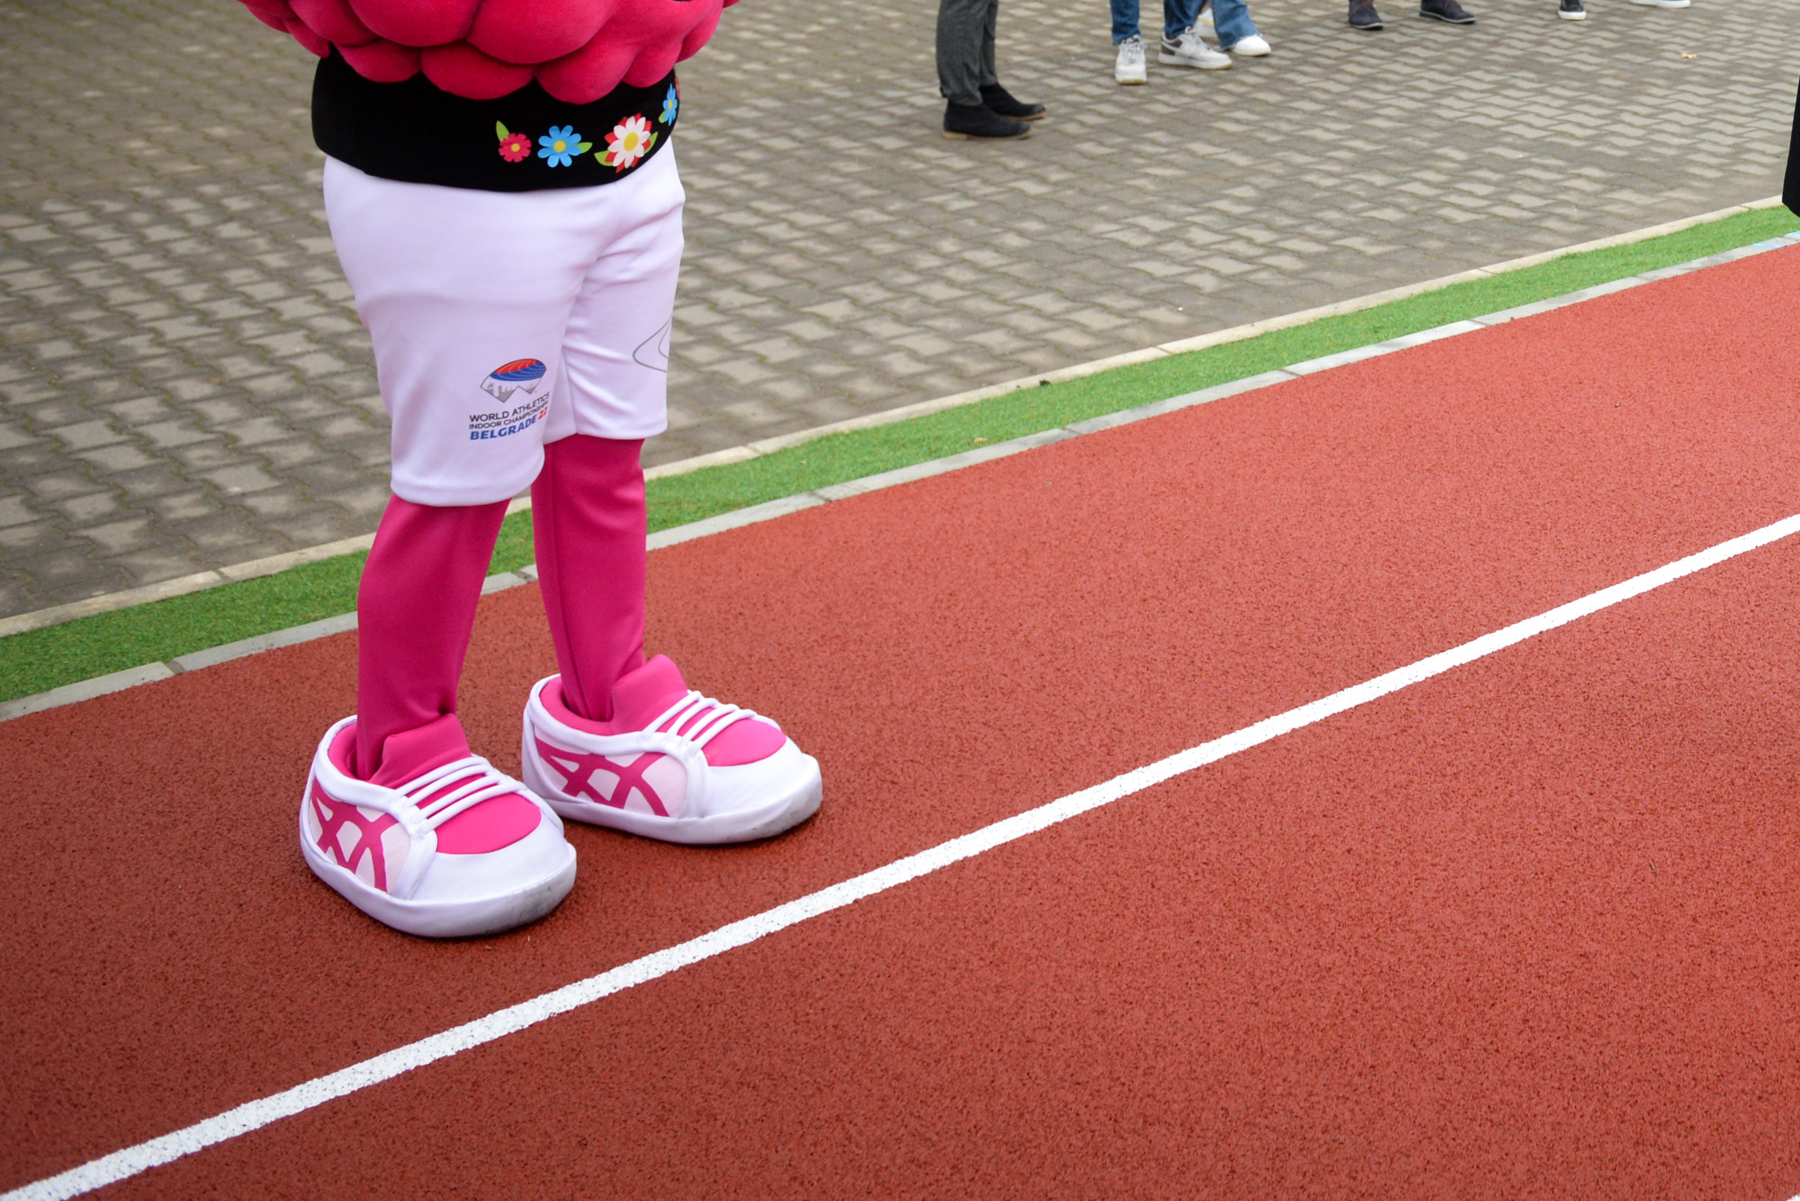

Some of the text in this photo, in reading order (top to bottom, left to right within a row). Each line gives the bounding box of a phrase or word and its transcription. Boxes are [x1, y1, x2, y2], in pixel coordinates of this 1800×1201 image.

[469, 391, 549, 422] WORLD ATHLETICS
[469, 421, 502, 430] INDOOR
[470, 406, 548, 440] BELGRADE 22
